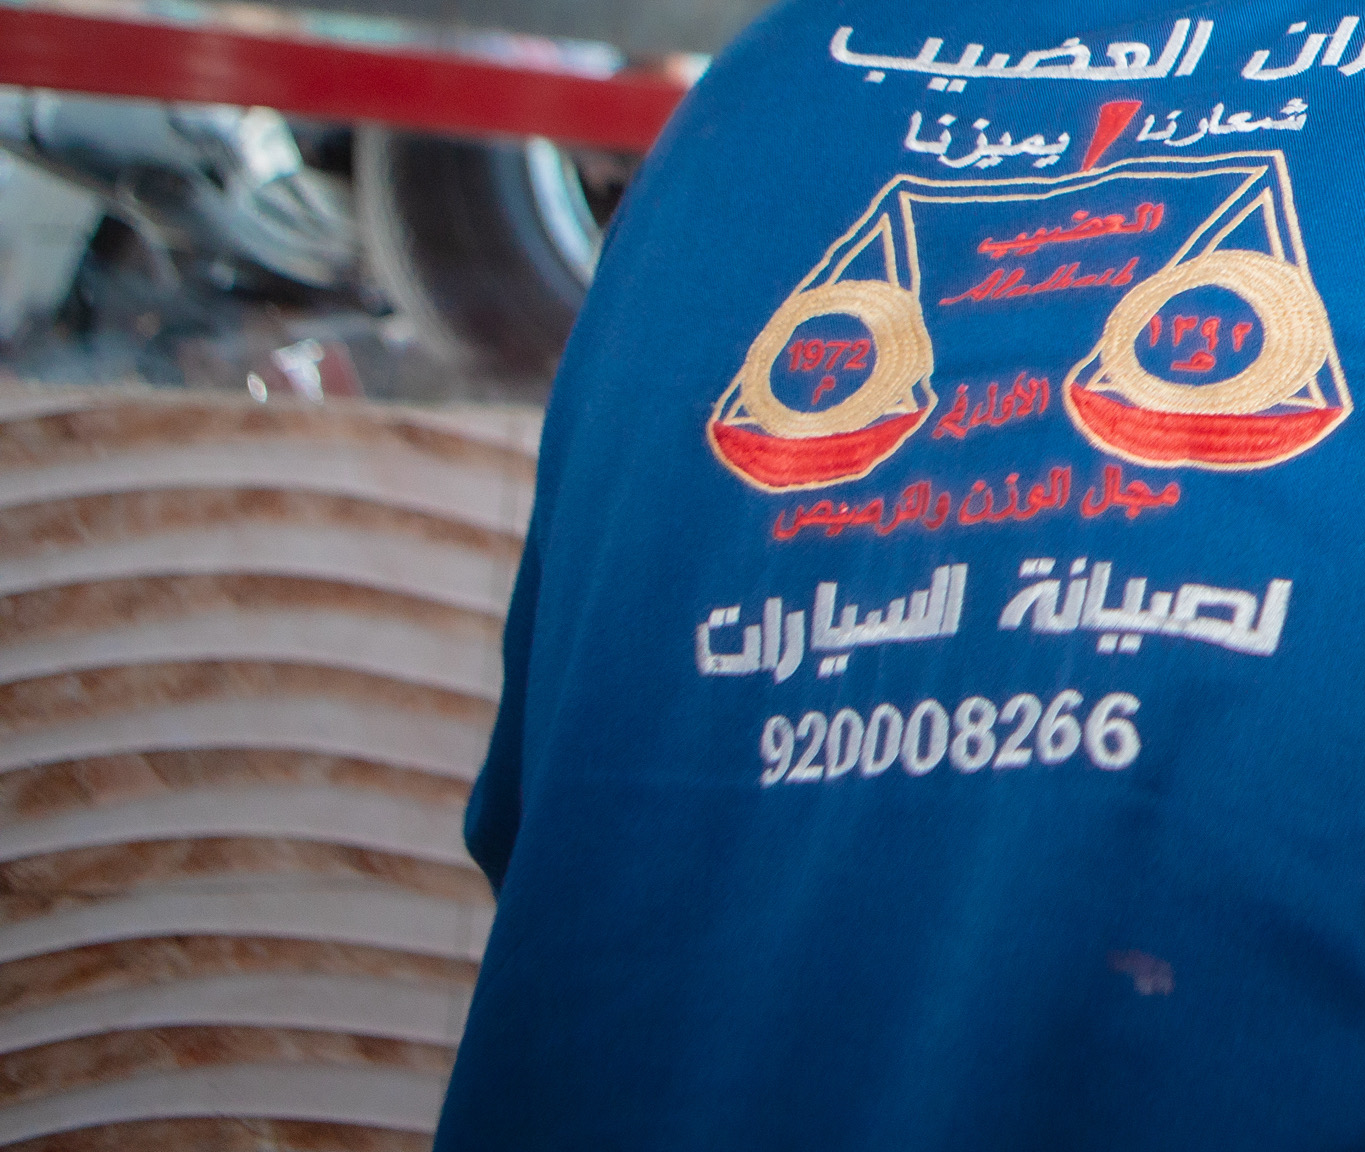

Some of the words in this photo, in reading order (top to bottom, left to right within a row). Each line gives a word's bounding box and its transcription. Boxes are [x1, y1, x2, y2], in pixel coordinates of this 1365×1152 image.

[829, 18, 1214, 94] العضيب
[903, 110, 1071, 169] يميزنا
[1136, 98, 1310, 148] شعارنا
[977, 202, 1165, 260] العضيب
[786, 338, 872, 372] 1972
[957, 464, 1072, 527] الوزن
[1080, 463, 1182, 520] مجال
[695, 562, 969, 684] السيارات
[999, 556, 1293, 657] لصيانة
[761, 689, 1142, 788] 920008266
